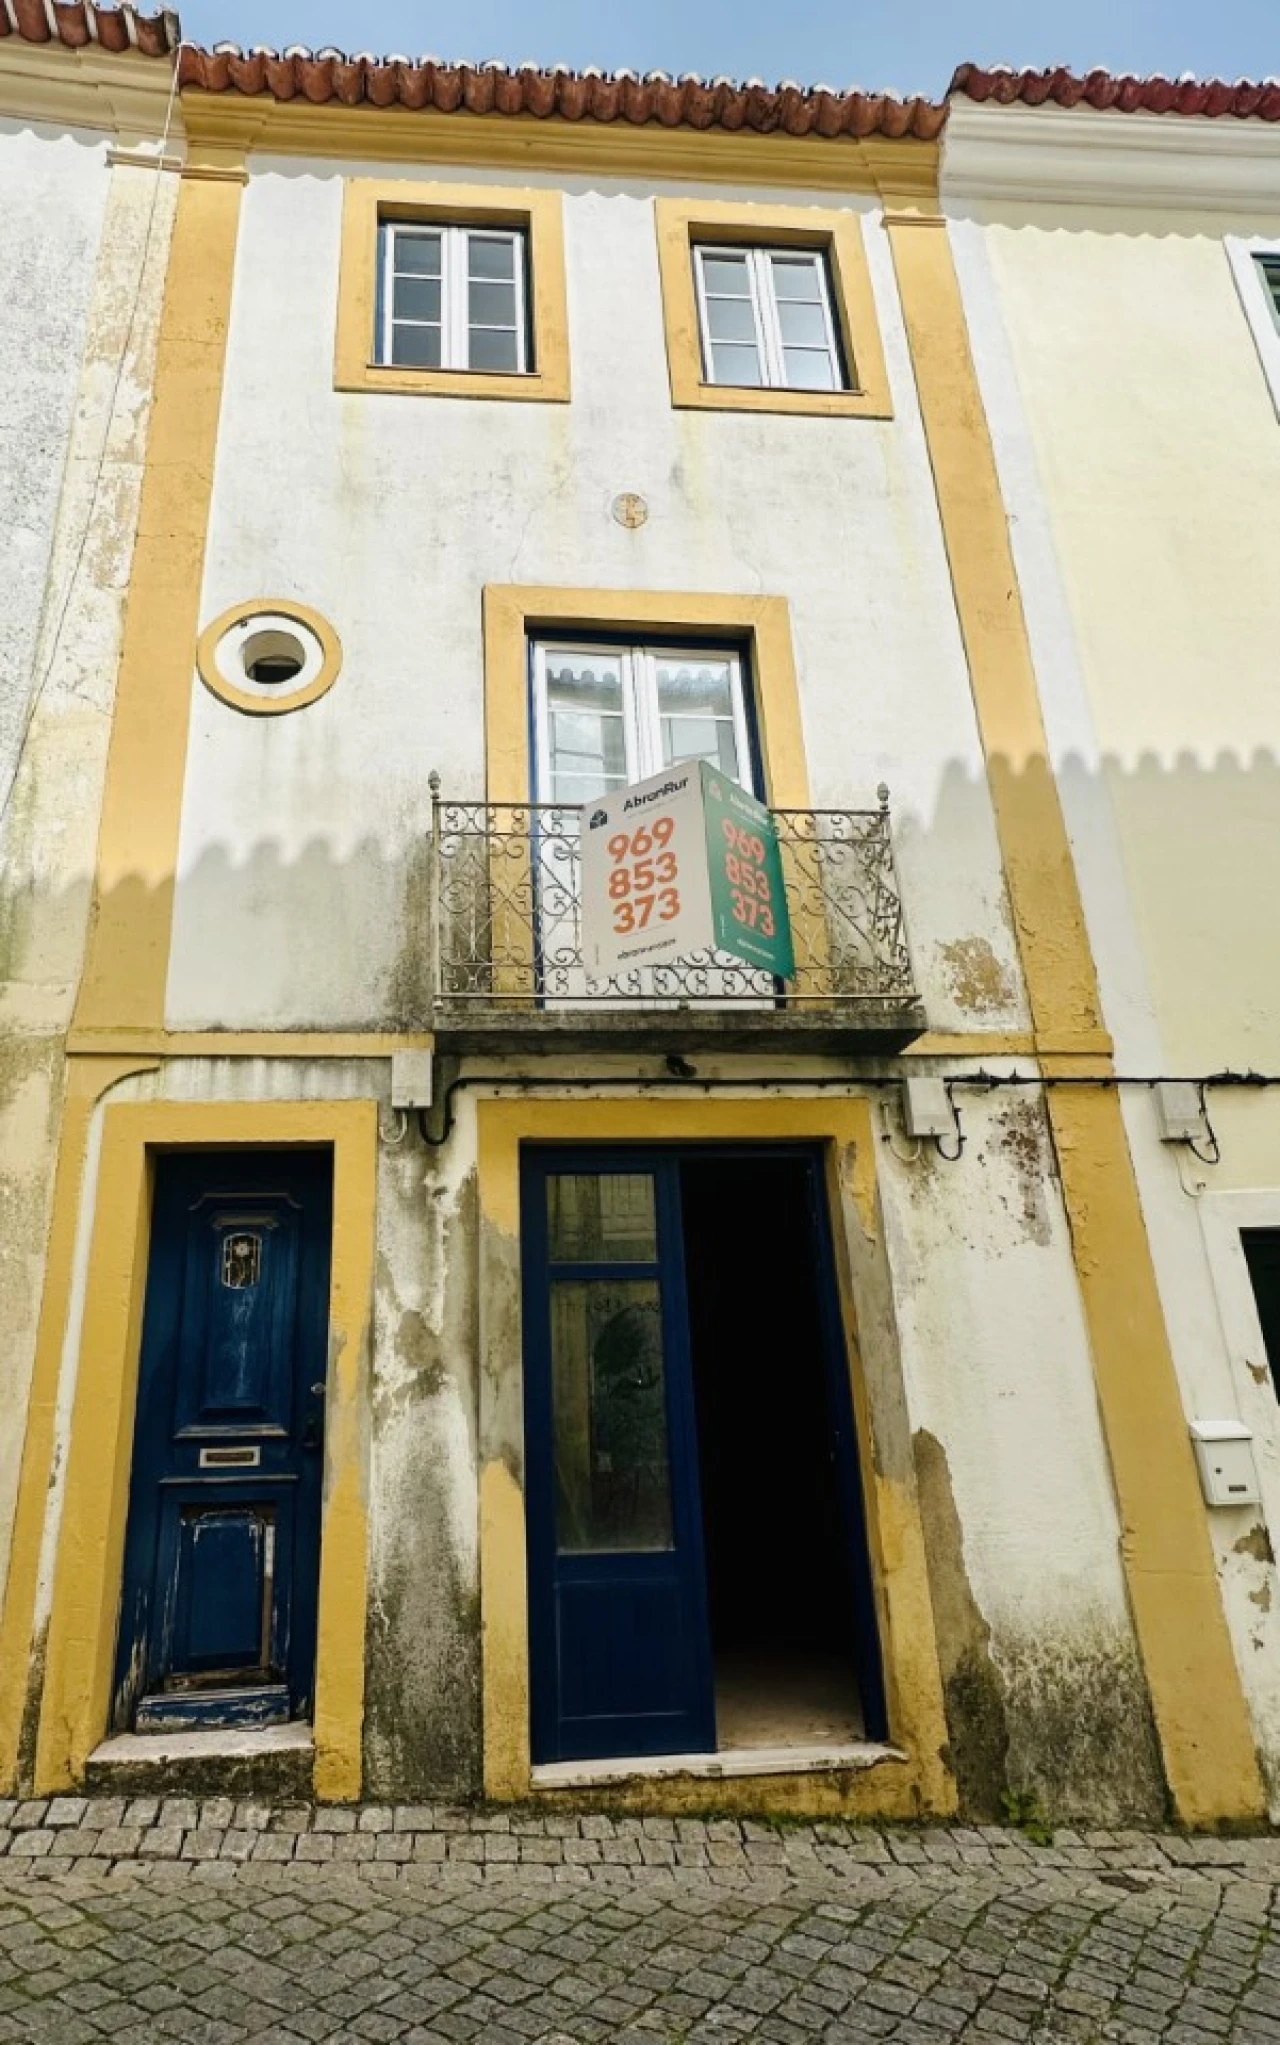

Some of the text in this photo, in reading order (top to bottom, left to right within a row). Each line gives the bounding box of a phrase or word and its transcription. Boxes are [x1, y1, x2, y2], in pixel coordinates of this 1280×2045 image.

[607, 817, 675, 864] 969
[722, 818, 765, 864] 969
[608, 851, 678, 900] 853
[725, 852, 770, 901] 853
[612, 887, 680, 934] 373
[730, 889, 775, 937] 373
